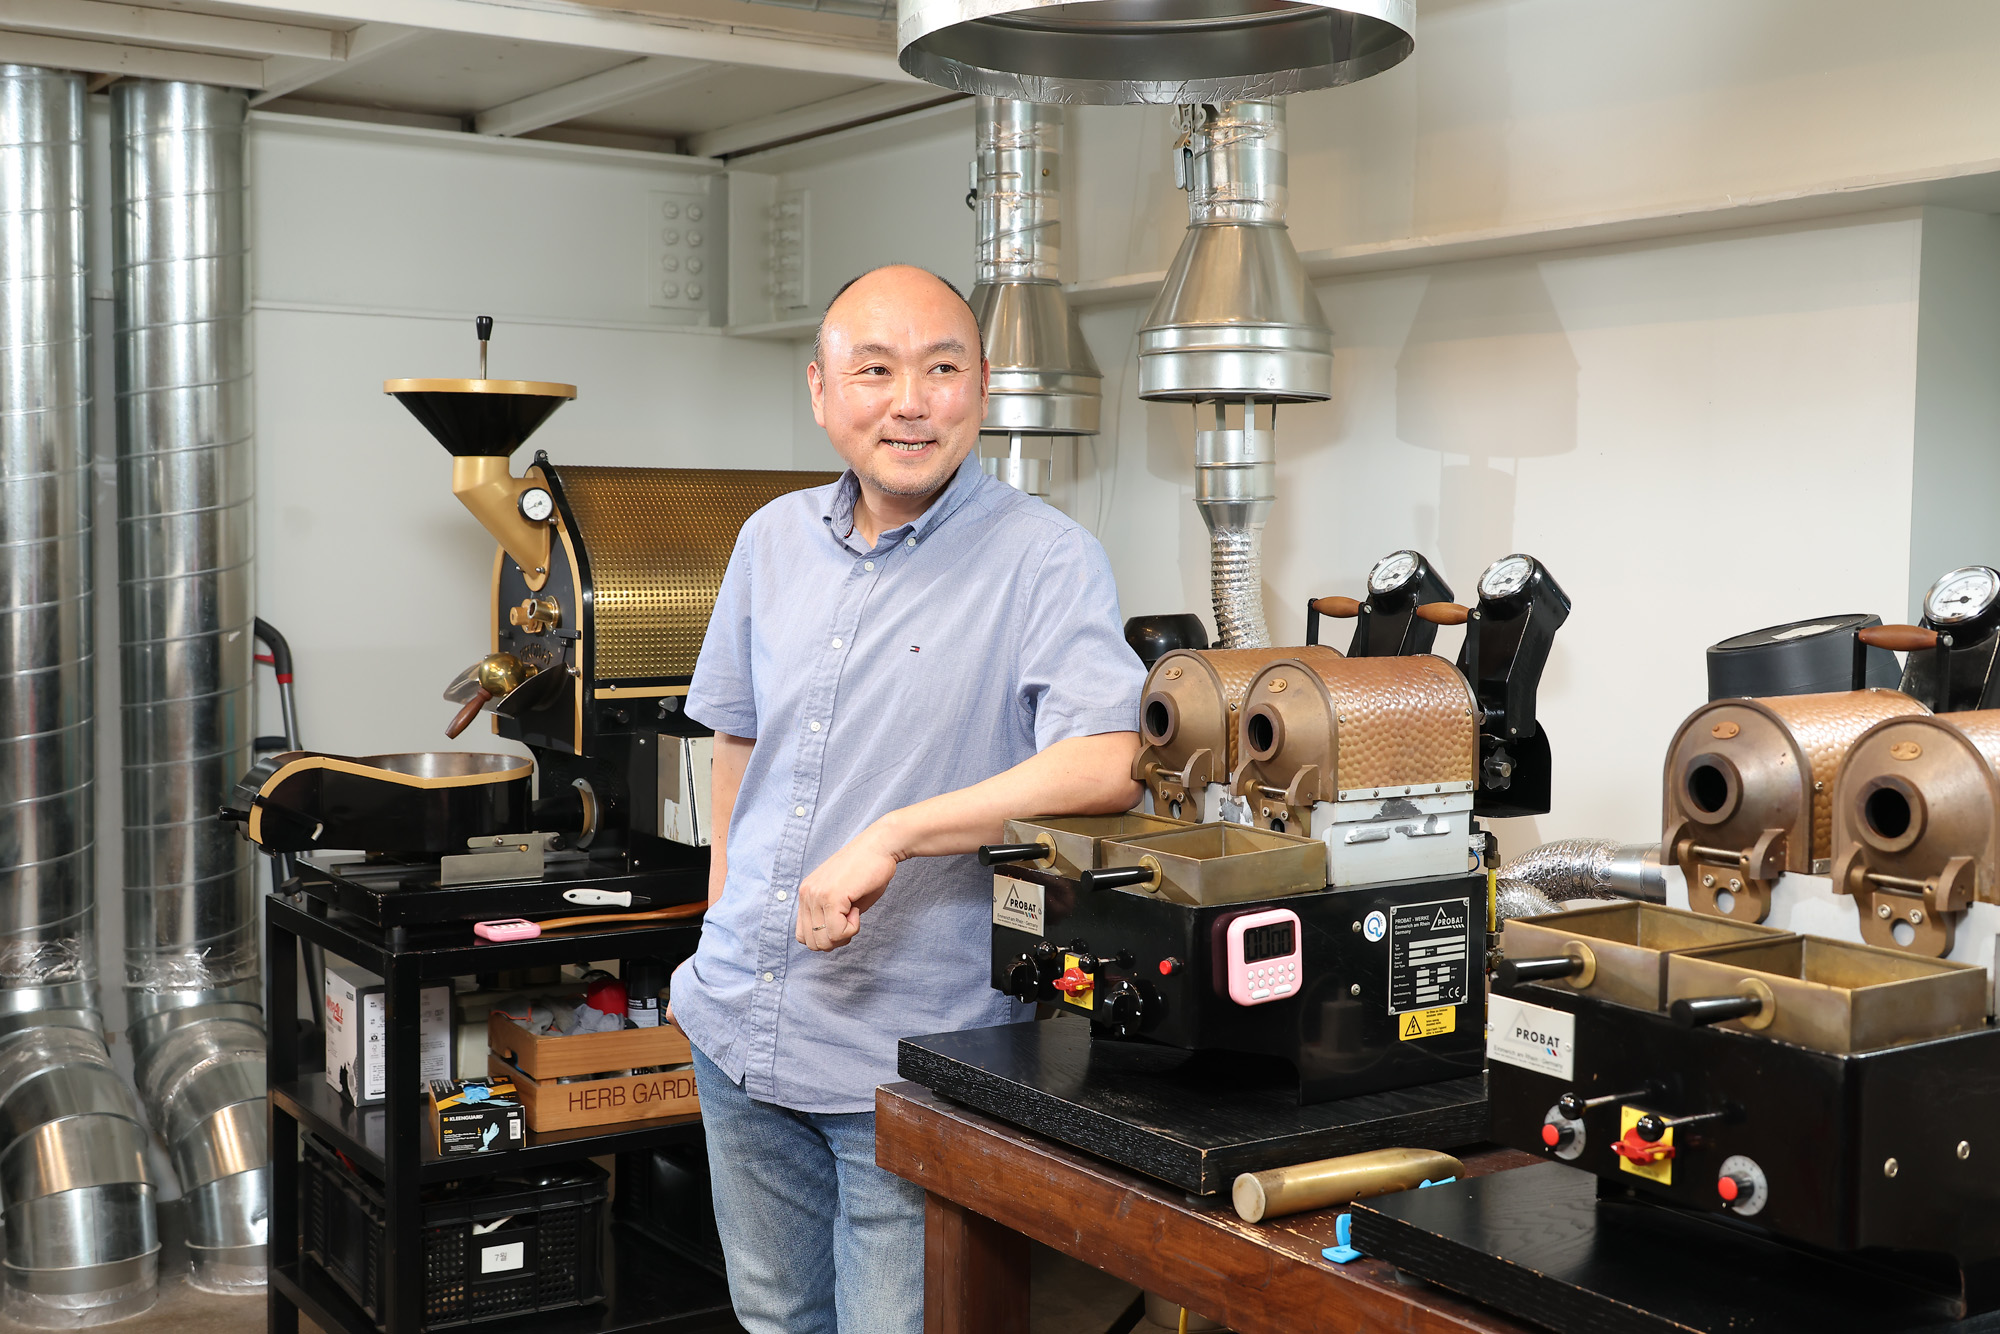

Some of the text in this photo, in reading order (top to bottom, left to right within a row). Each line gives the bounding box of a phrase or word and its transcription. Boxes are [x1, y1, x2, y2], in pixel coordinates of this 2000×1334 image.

[1010, 898, 1036, 912] PROBAT
[1437, 916, 1463, 926] PROBAT
[1516, 1027, 1560, 1048] PROBAT
[568, 1085, 626, 1112] HERB
